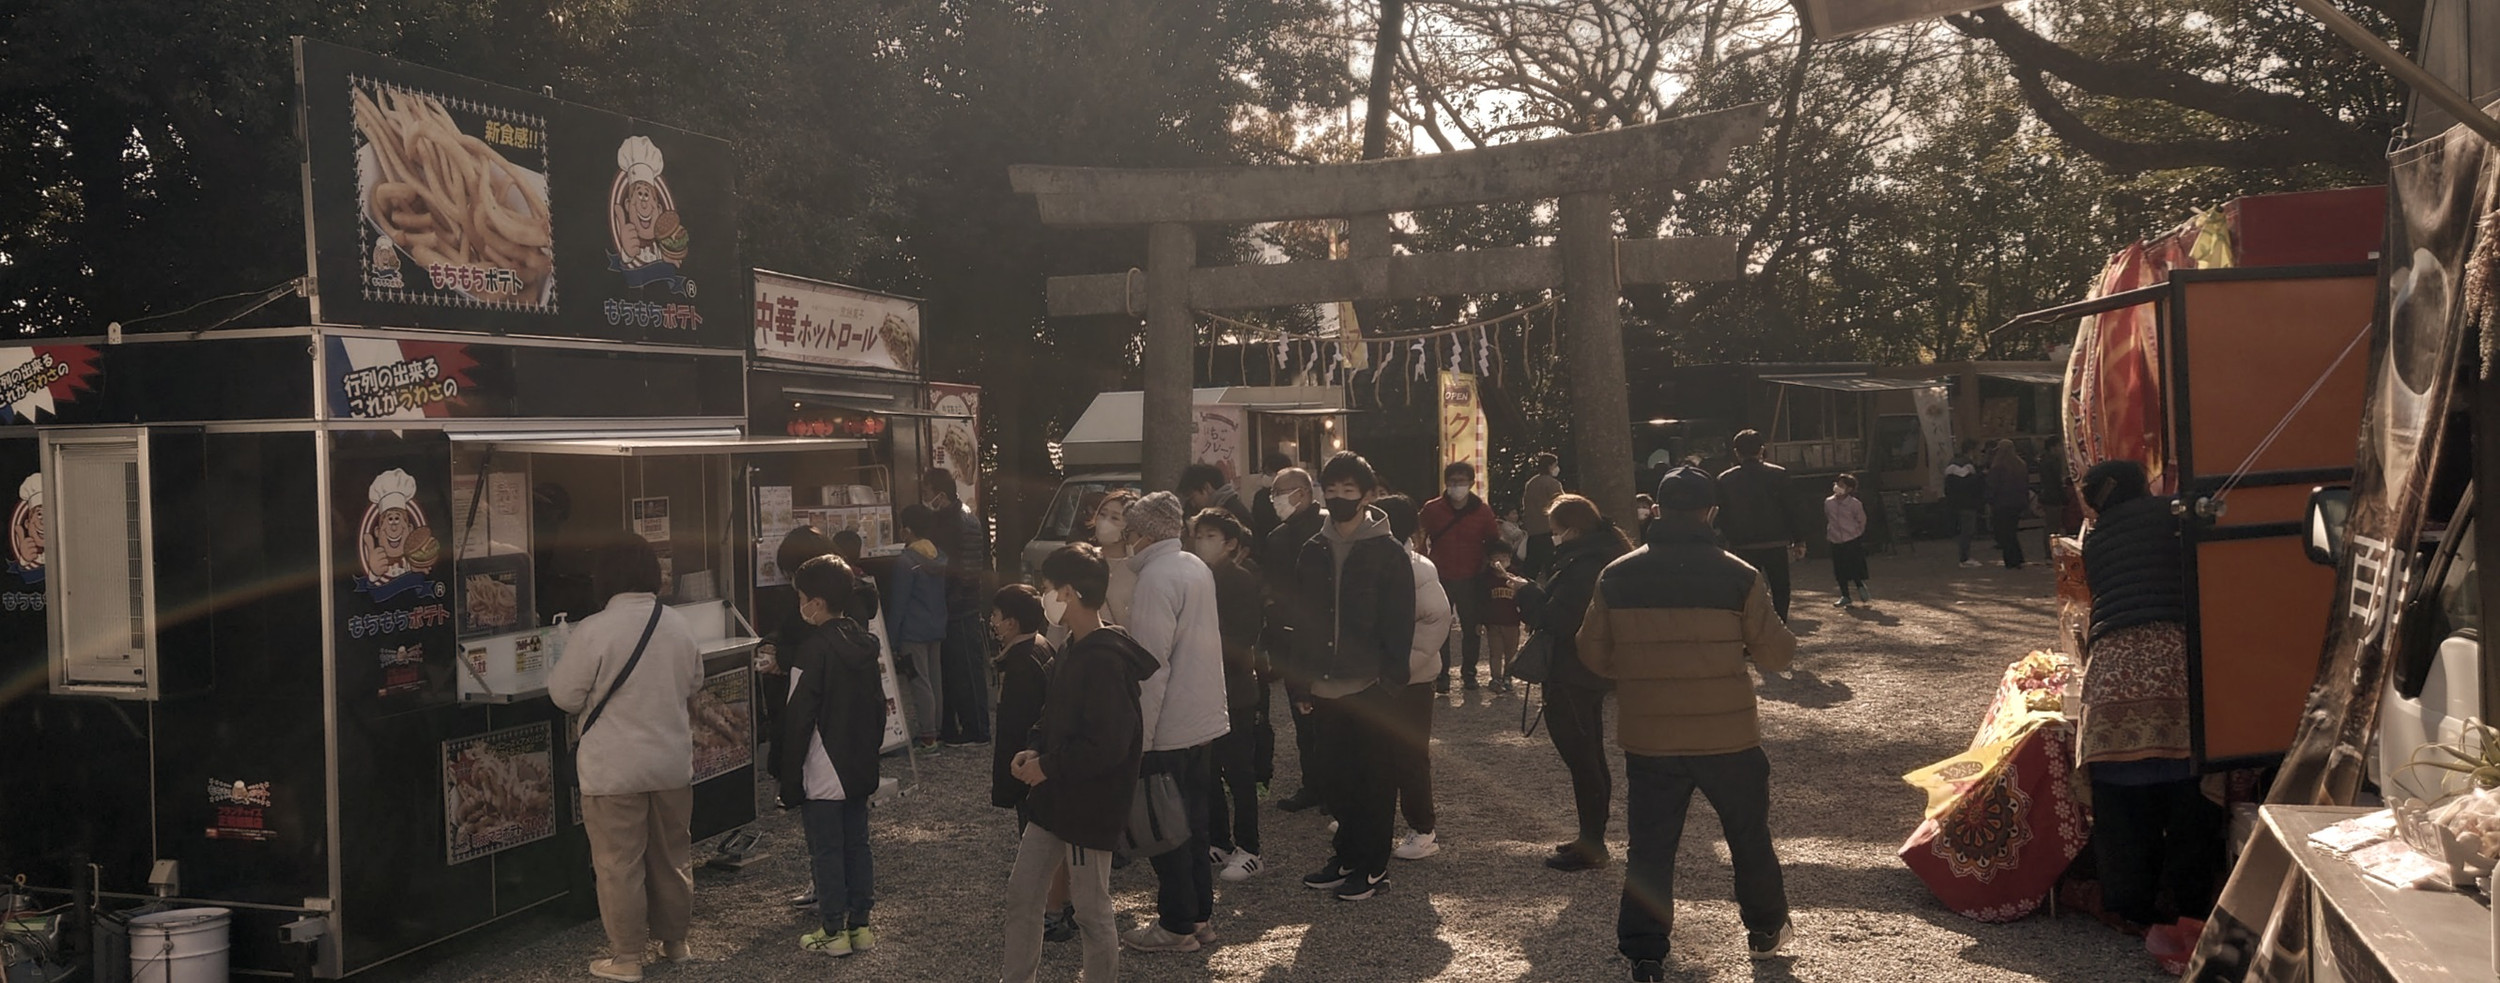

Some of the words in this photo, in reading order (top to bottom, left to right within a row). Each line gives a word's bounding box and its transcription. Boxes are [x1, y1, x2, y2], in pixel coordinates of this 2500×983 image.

[485, 119, 539, 150] 新食感!!
[428, 263, 523, 295] もちもちポテト
[603, 298, 704, 331] もちもちポテト
[342, 357, 440, 398] 行列の出来る
[349, 376, 458, 418] これがうわさの
[1445, 391, 1469, 401] OPEN
[2, 591, 47, 612] もちも
[347, 603, 451, 639] もちもちポテト
